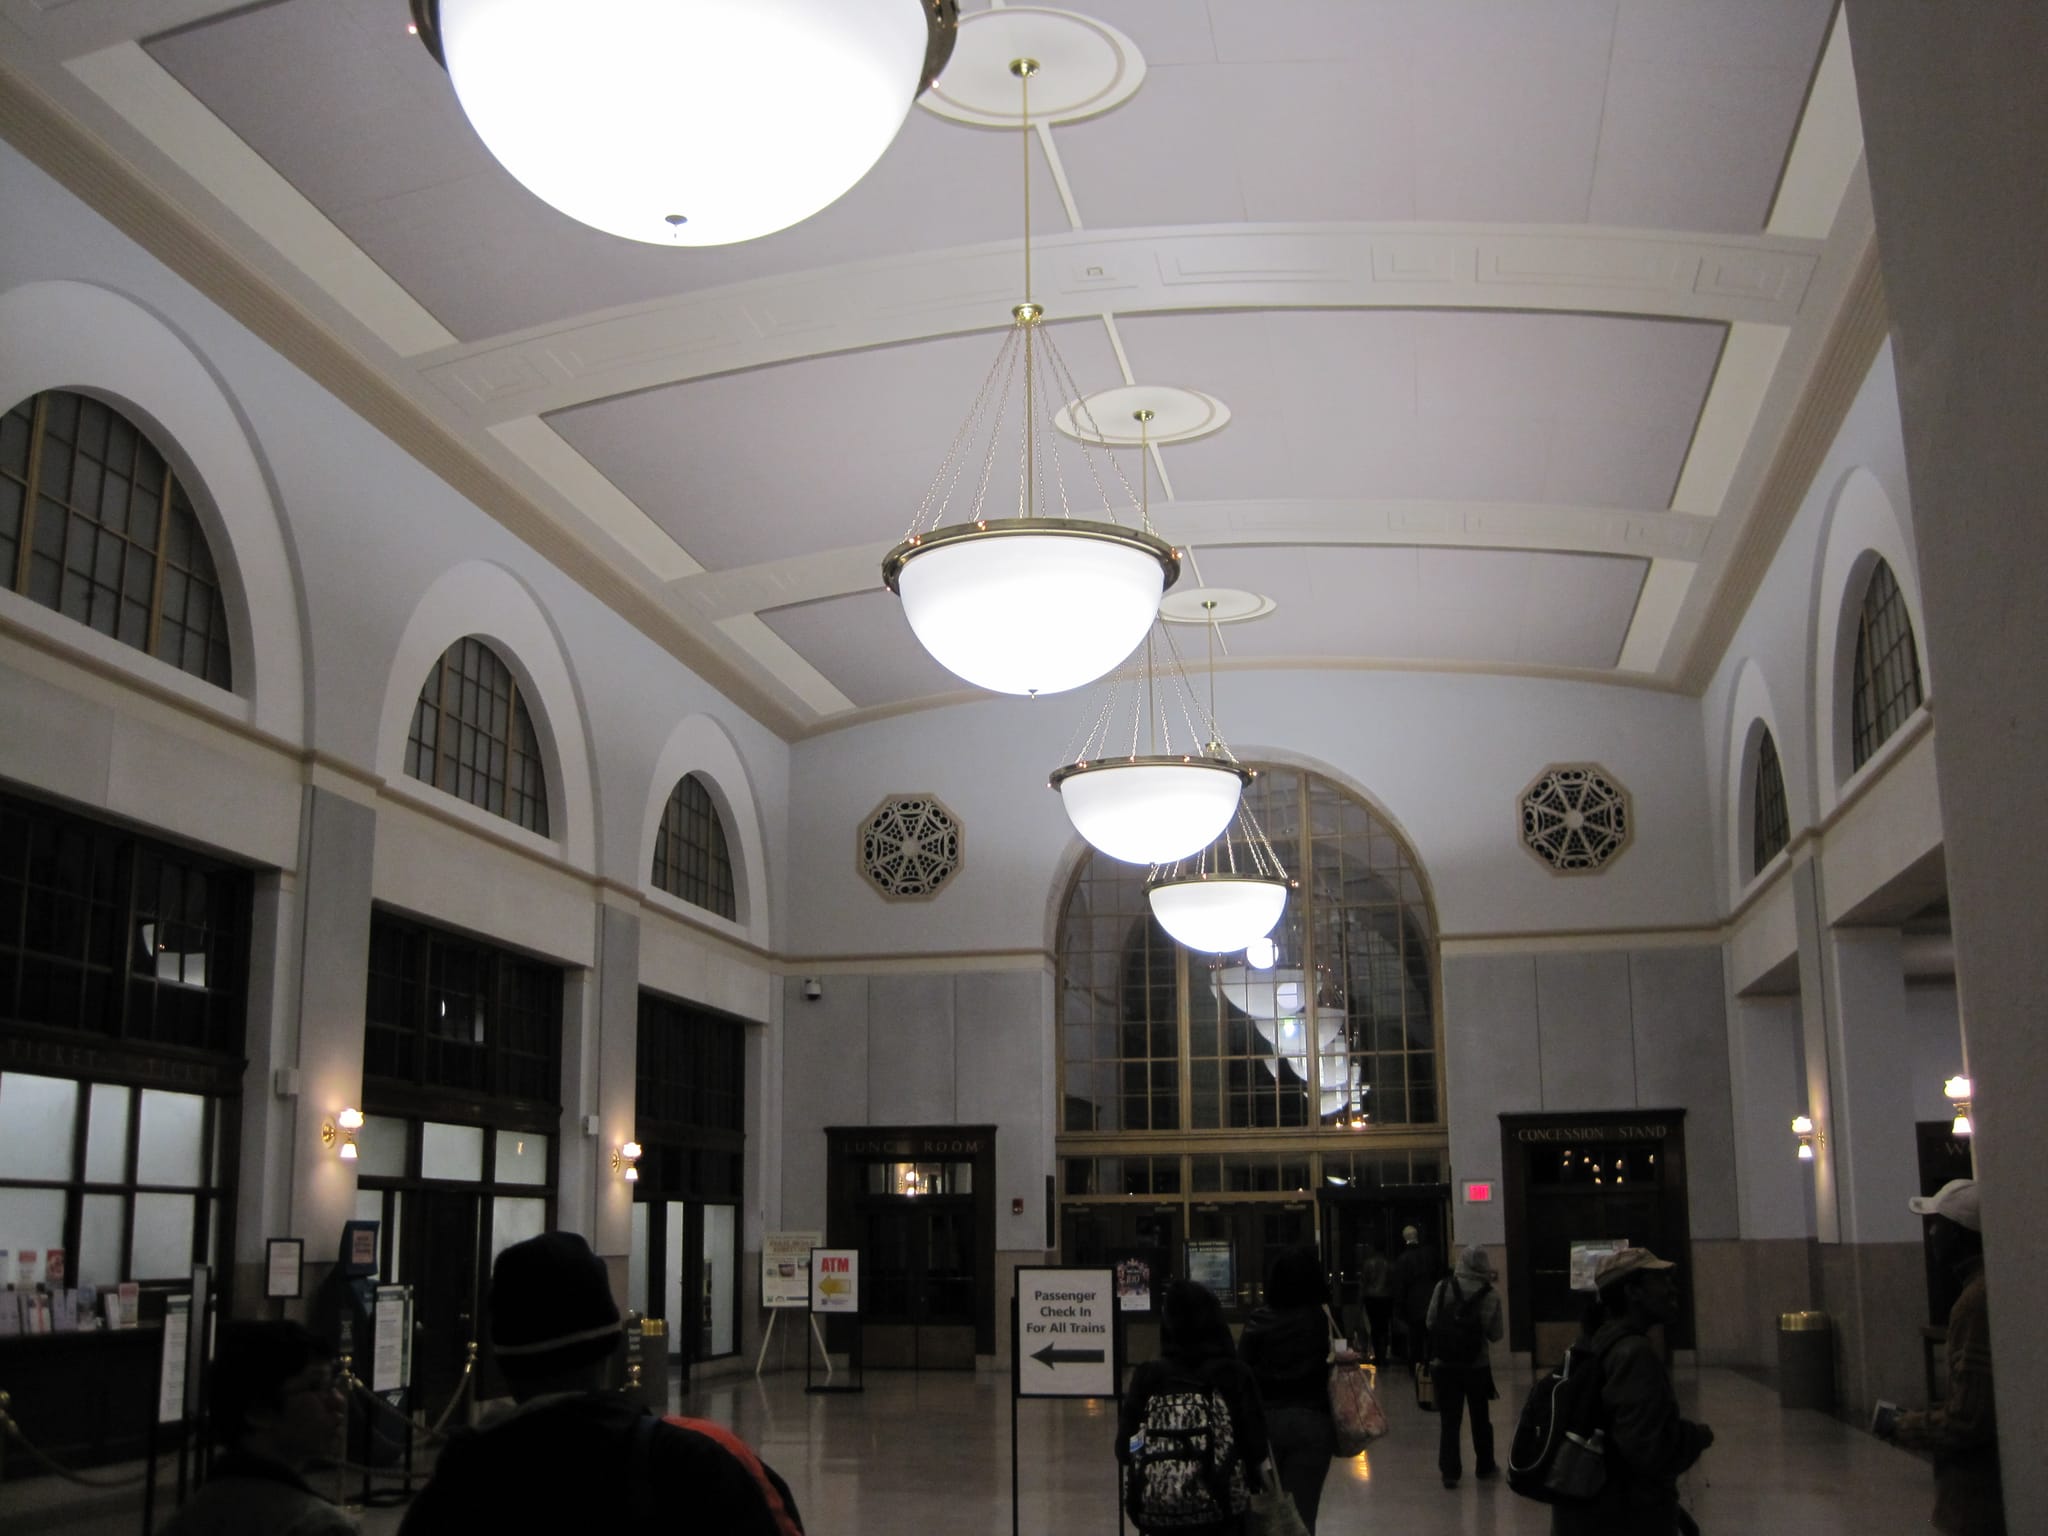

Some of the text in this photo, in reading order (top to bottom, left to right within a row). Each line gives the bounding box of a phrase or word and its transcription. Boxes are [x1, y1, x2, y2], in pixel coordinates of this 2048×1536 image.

[1518, 1125, 1666, 1142] CONCESSION STAND
[843, 1140, 978, 1153] LUNC ROOM
[821, 1257, 849, 1273] ATM
[1034, 1290, 1096, 1303] Passenger
[1040, 1306, 1092, 1317] Check In
[1026, 1322, 1106, 1333] For All Trains
